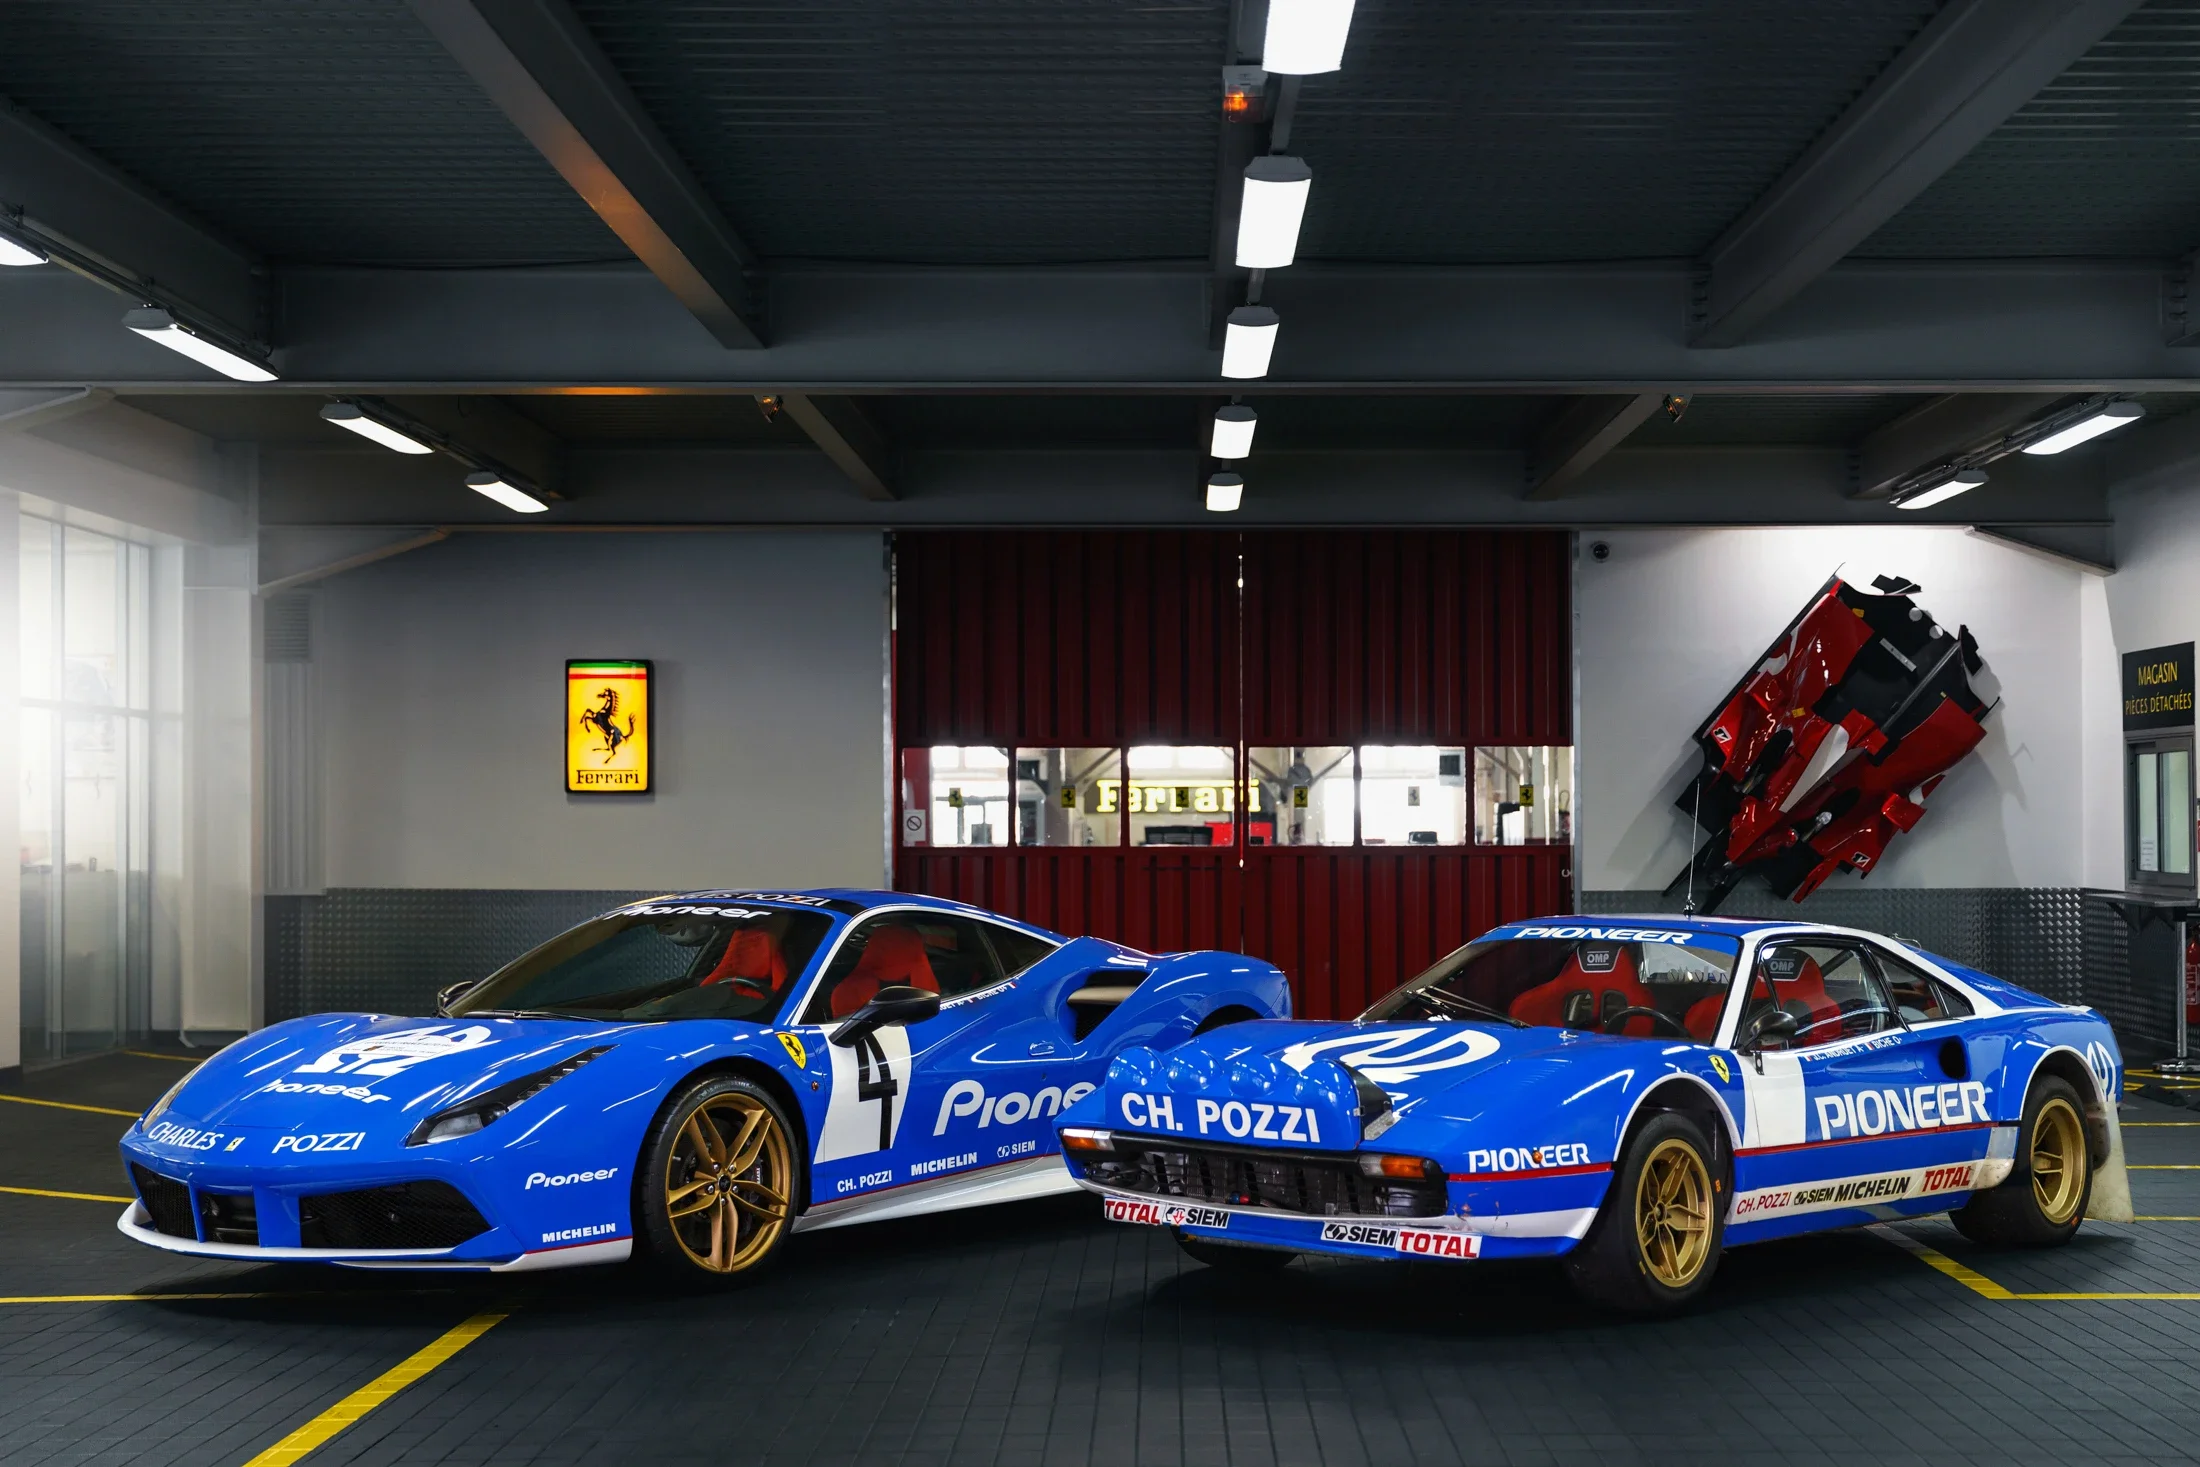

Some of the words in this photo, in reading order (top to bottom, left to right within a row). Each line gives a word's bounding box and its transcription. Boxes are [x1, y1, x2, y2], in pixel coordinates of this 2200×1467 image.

[2138, 661, 2178, 686] MAGASIN
[2125, 695, 2148, 715] PIÈCES
[2150, 689, 2192, 713] DÉTACHÉES
[576, 769, 639, 785] Ferrari
[736, 893, 832, 907] POZZI
[1513, 926, 1694, 945] PIONEER
[1586, 951, 1610, 964] OMP
[1770, 959, 1795, 972] OMP
[1872, 1036, 1895, 1049] BICHE
[854, 1031, 898, 1151] 4
[1121, 1092, 1184, 1132] CH.
[1196, 1098, 1321, 1143] POZZI
[1814, 1080, 1990, 1140] PIONEER
[148, 1121, 224, 1151] CHARLES
[271, 1131, 366, 1154] POZZI
[1011, 1140, 1036, 1155] SIEM
[910, 1152, 978, 1177] MICHELIN
[1468, 1142, 1592, 1173] PIONEER
[524, 1167, 618, 1190] Pioneer
[837, 1178, 857, 1192] CH.
[860, 1170, 893, 1188] POZZI
[1834, 1177, 1911, 1202] MICHELIN
[1922, 1166, 1972, 1193] TOTAL
[1807, 1187, 1833, 1204] SIEM
[1105, 1200, 1161, 1224] TOTAL
[1185, 1208, 1229, 1228] SIEM
[542, 1222, 616, 1243] MICHELIN
[1347, 1226, 1396, 1247] SIEM
[1399, 1231, 1478, 1258] TOTAL
